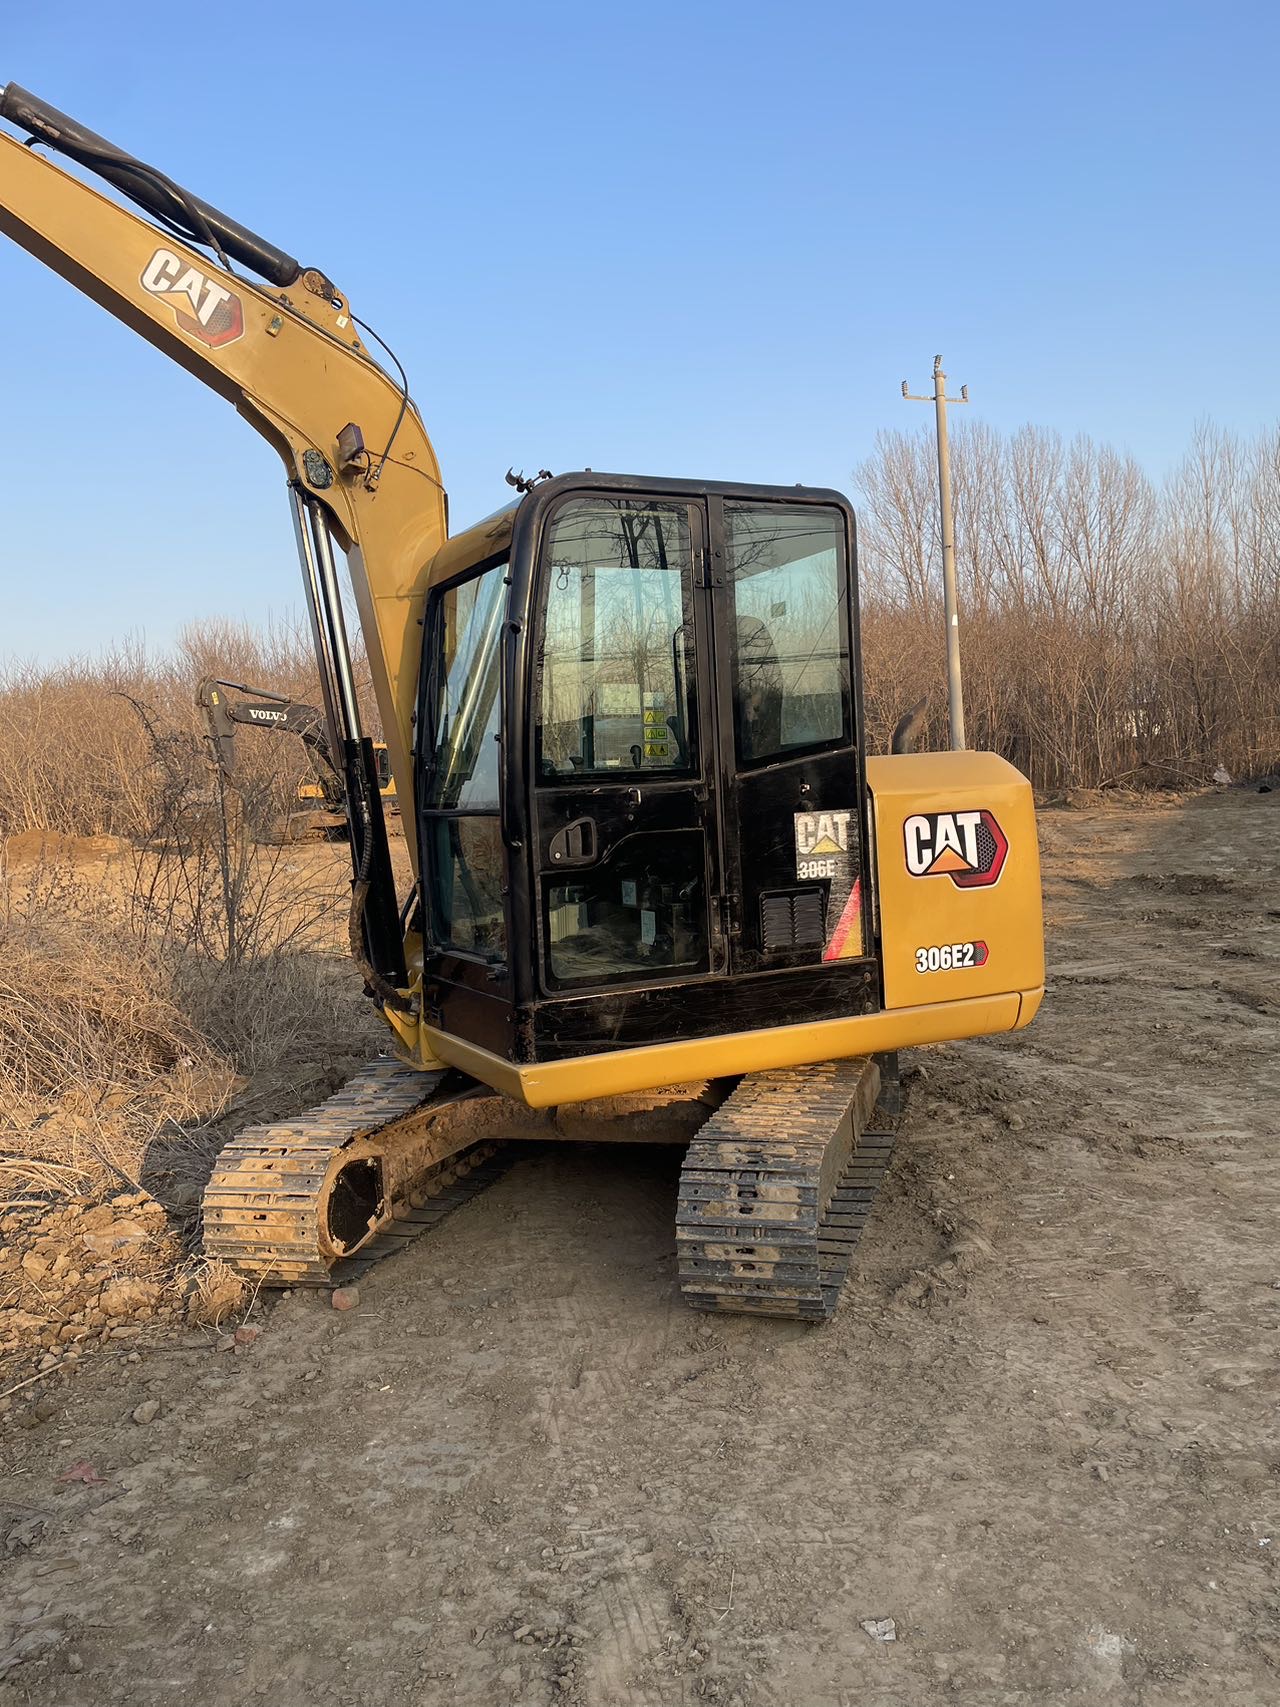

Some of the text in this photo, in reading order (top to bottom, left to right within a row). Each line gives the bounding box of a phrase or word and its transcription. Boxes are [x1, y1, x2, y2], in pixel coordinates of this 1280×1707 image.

[142, 249, 231, 326] CAT
[249, 709, 287, 721] VOLVO
[797, 813, 850, 854] CAT
[904, 812, 981, 875] CAT
[916, 943, 974, 972] 306E2
